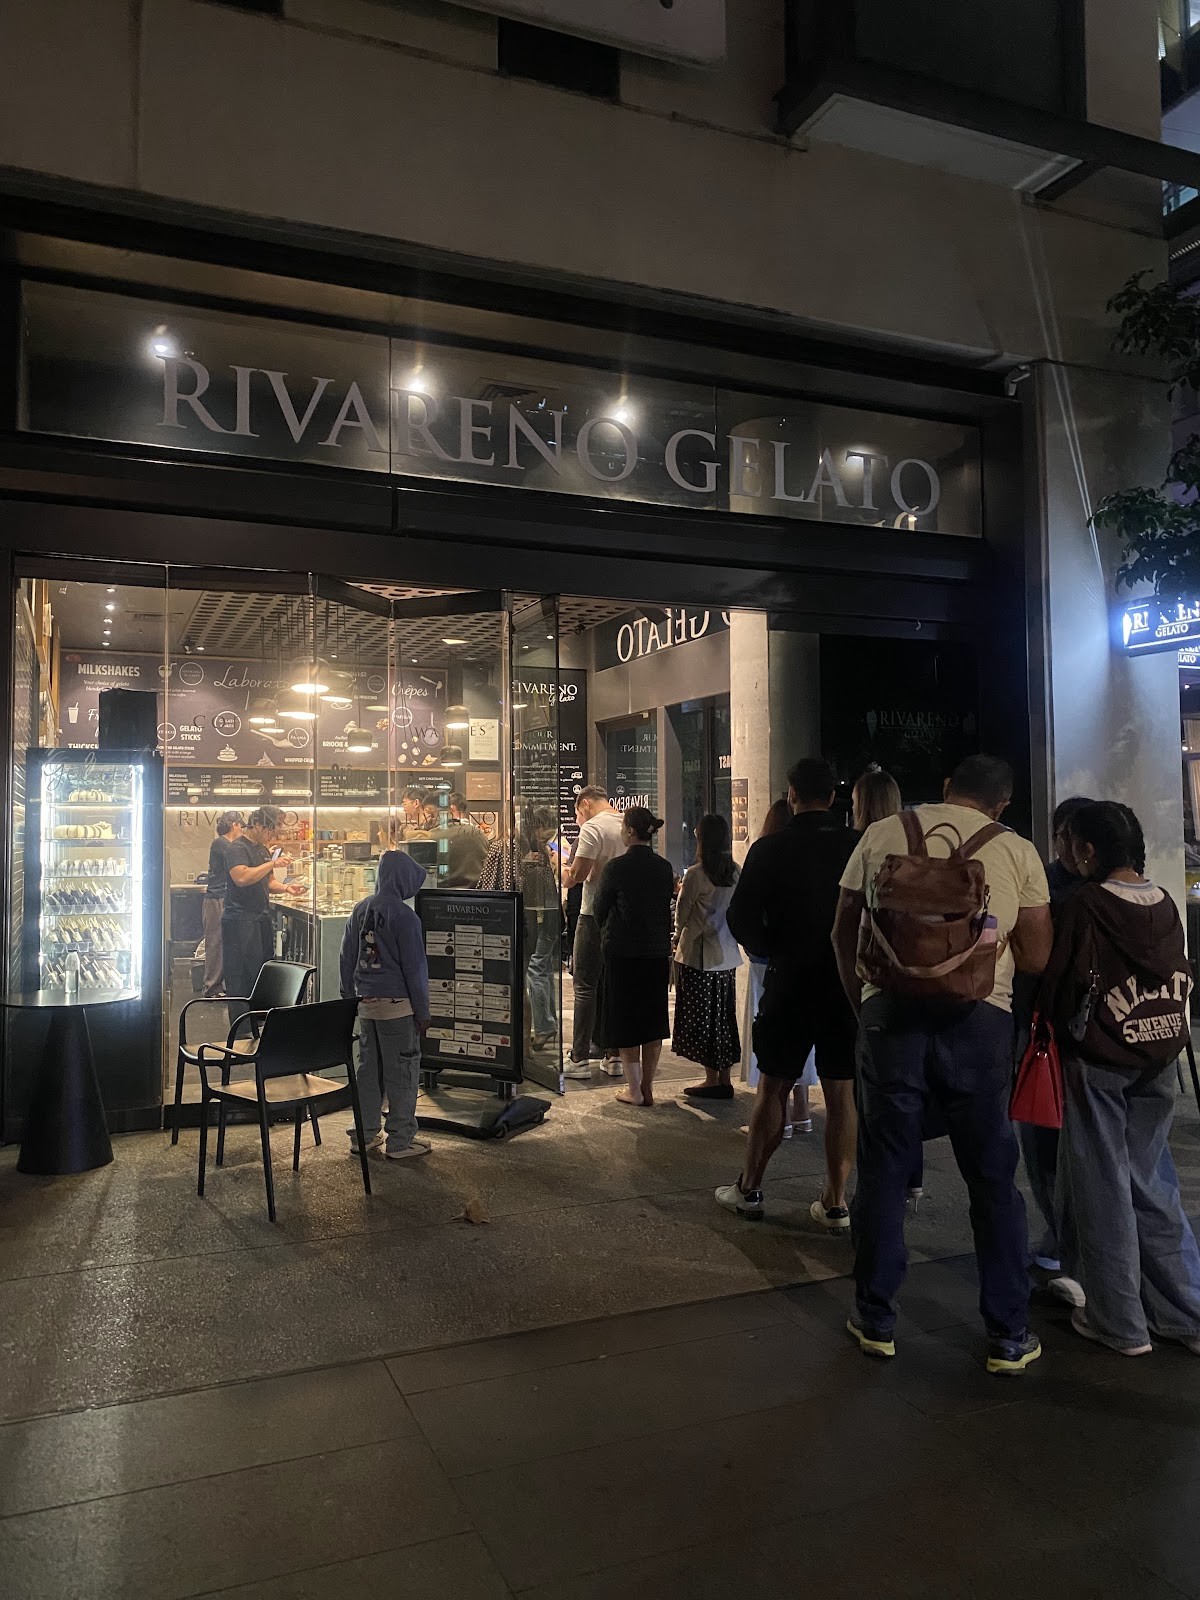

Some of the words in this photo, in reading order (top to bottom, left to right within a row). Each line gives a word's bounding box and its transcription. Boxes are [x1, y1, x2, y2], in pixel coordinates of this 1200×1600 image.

[154, 354, 639, 482] RIVARENO
[664, 429, 941, 517] GELATO
[1155, 623, 1189, 638] GELATO
[1178, 654, 1197, 664] LATO
[77, 663, 141, 678] MILKSHAKES
[391, 681, 429, 699] Crêpes
[512, 681, 578, 696] IVARENO
[548, 691, 576, 706] Glato
[179, 725, 202, 733] GELATO
[180, 733, 202, 741] STICKS
[512, 741, 578, 752] OMMITMENT:
[446, 904, 490, 915] RIVARENO
[1138, 1012, 1182, 1032] AVENUE
[1135, 1026, 1173, 1042] UNITED
